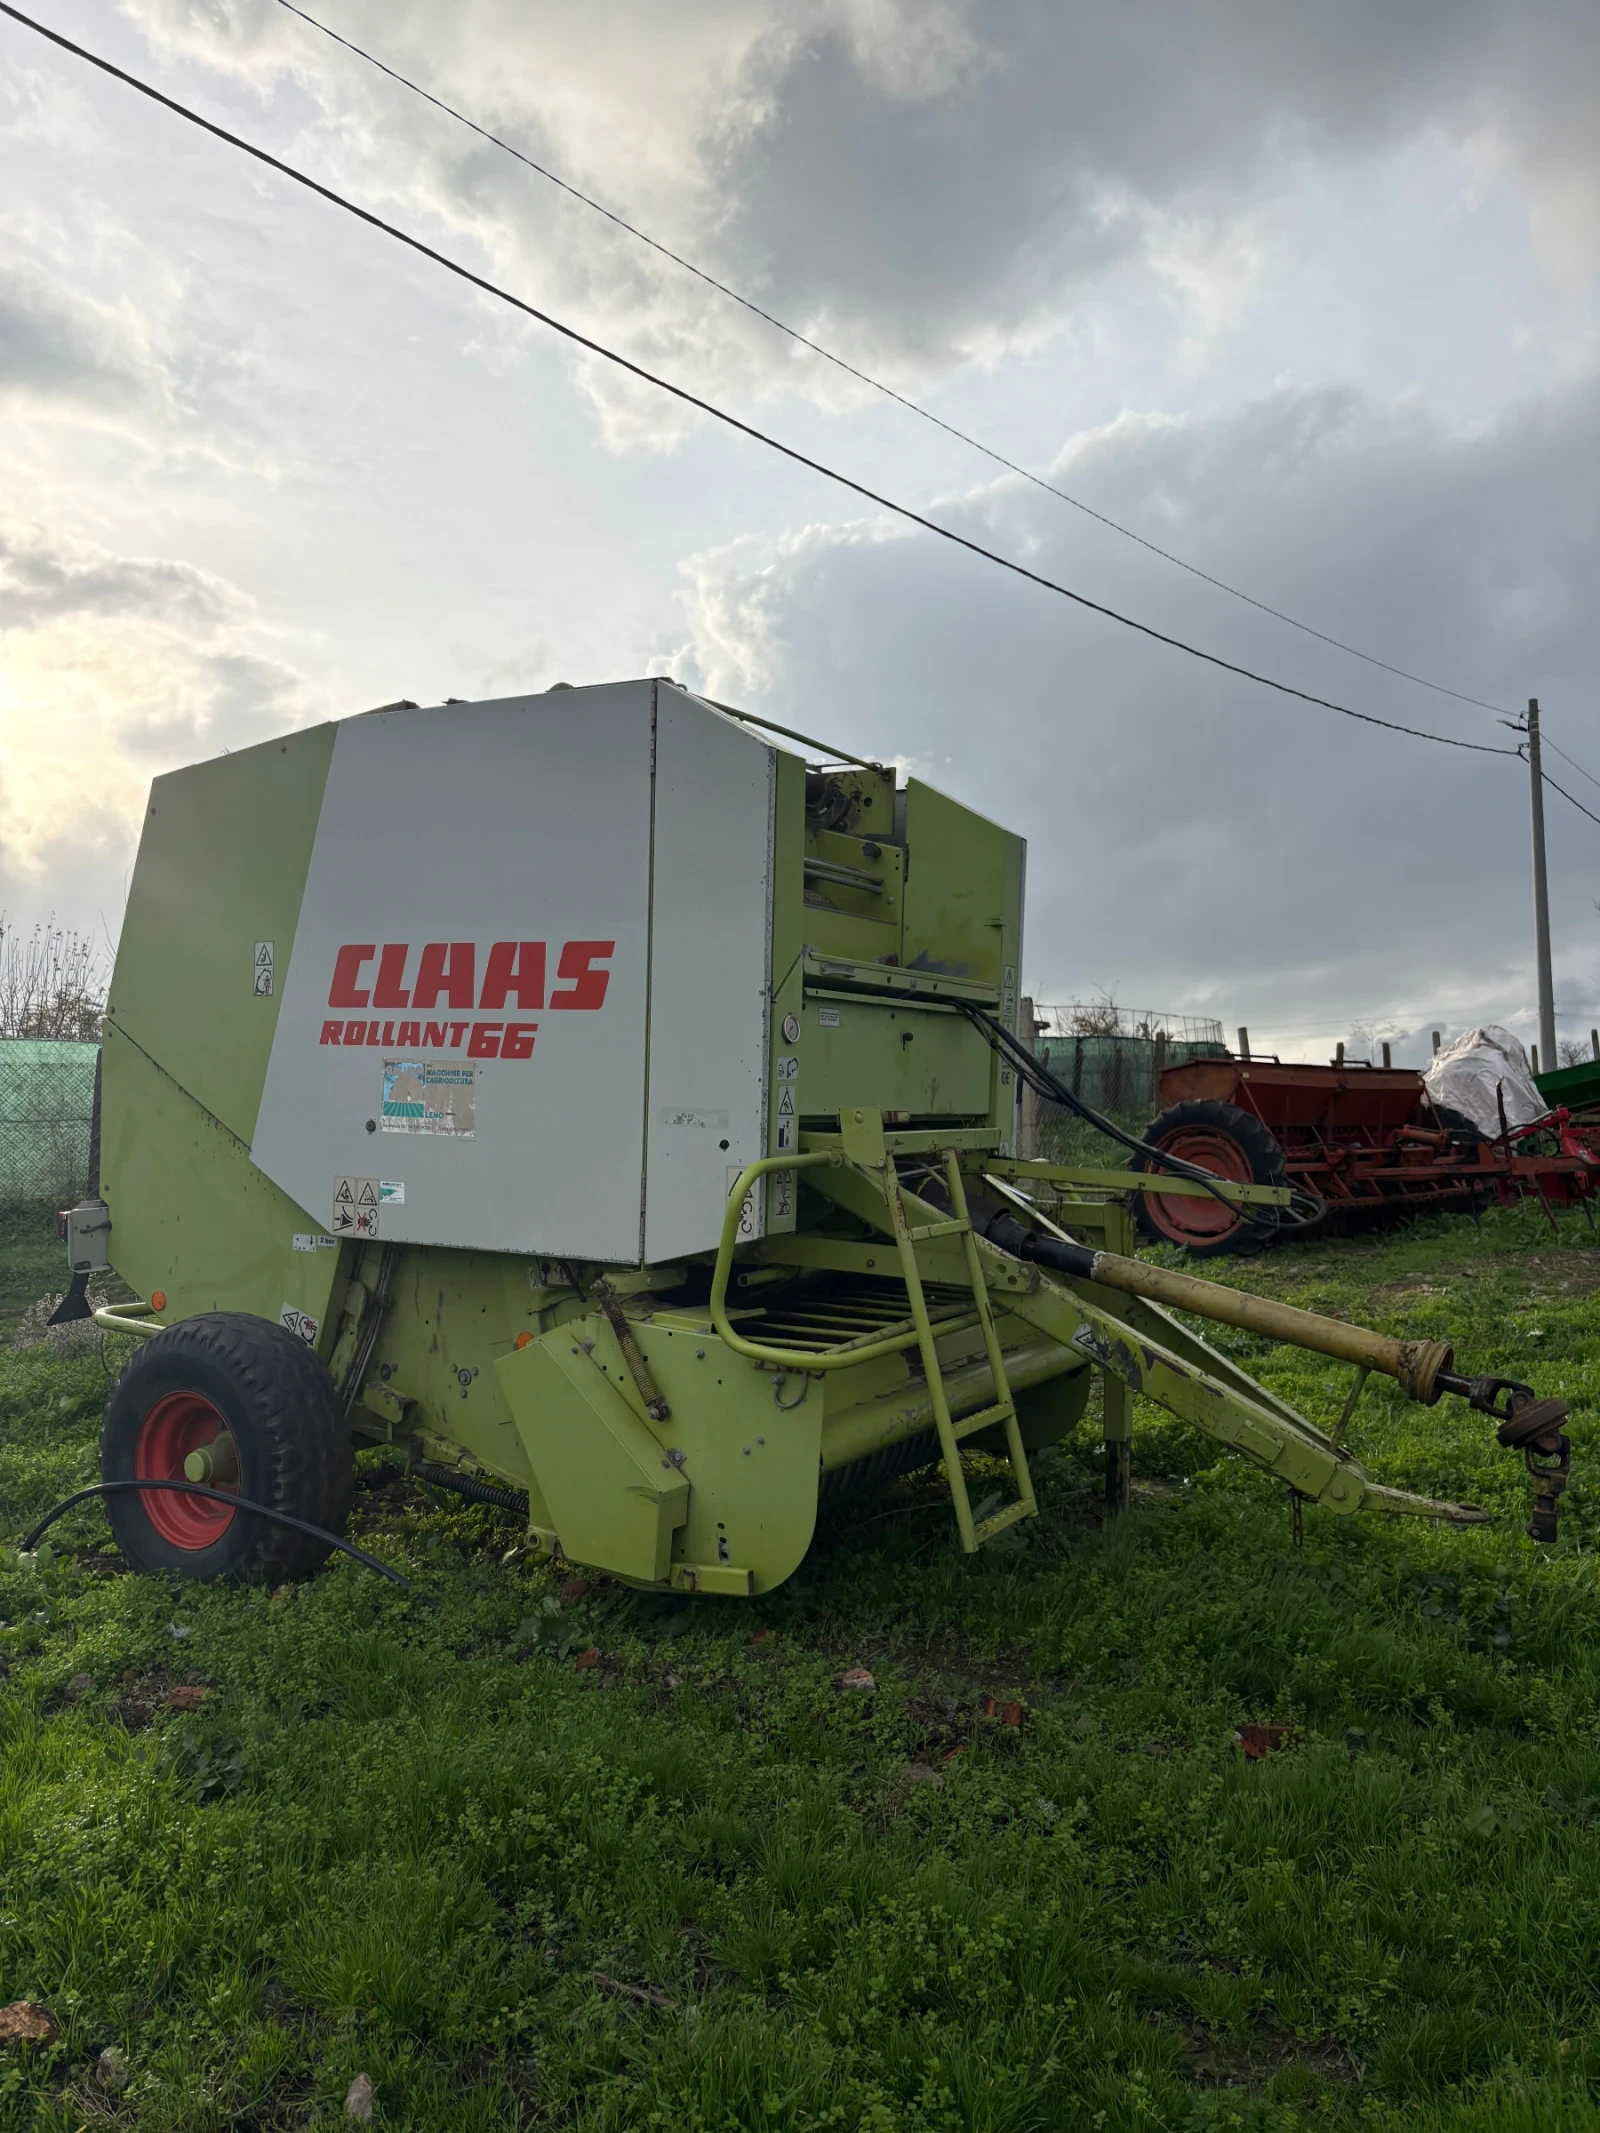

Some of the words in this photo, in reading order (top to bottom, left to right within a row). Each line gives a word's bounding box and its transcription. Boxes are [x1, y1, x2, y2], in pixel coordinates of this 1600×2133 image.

[328, 941, 615, 1010] CLAAS
[426, 1069, 461, 1077] MACCHINE
[425, 1111, 444, 1119] LENO
